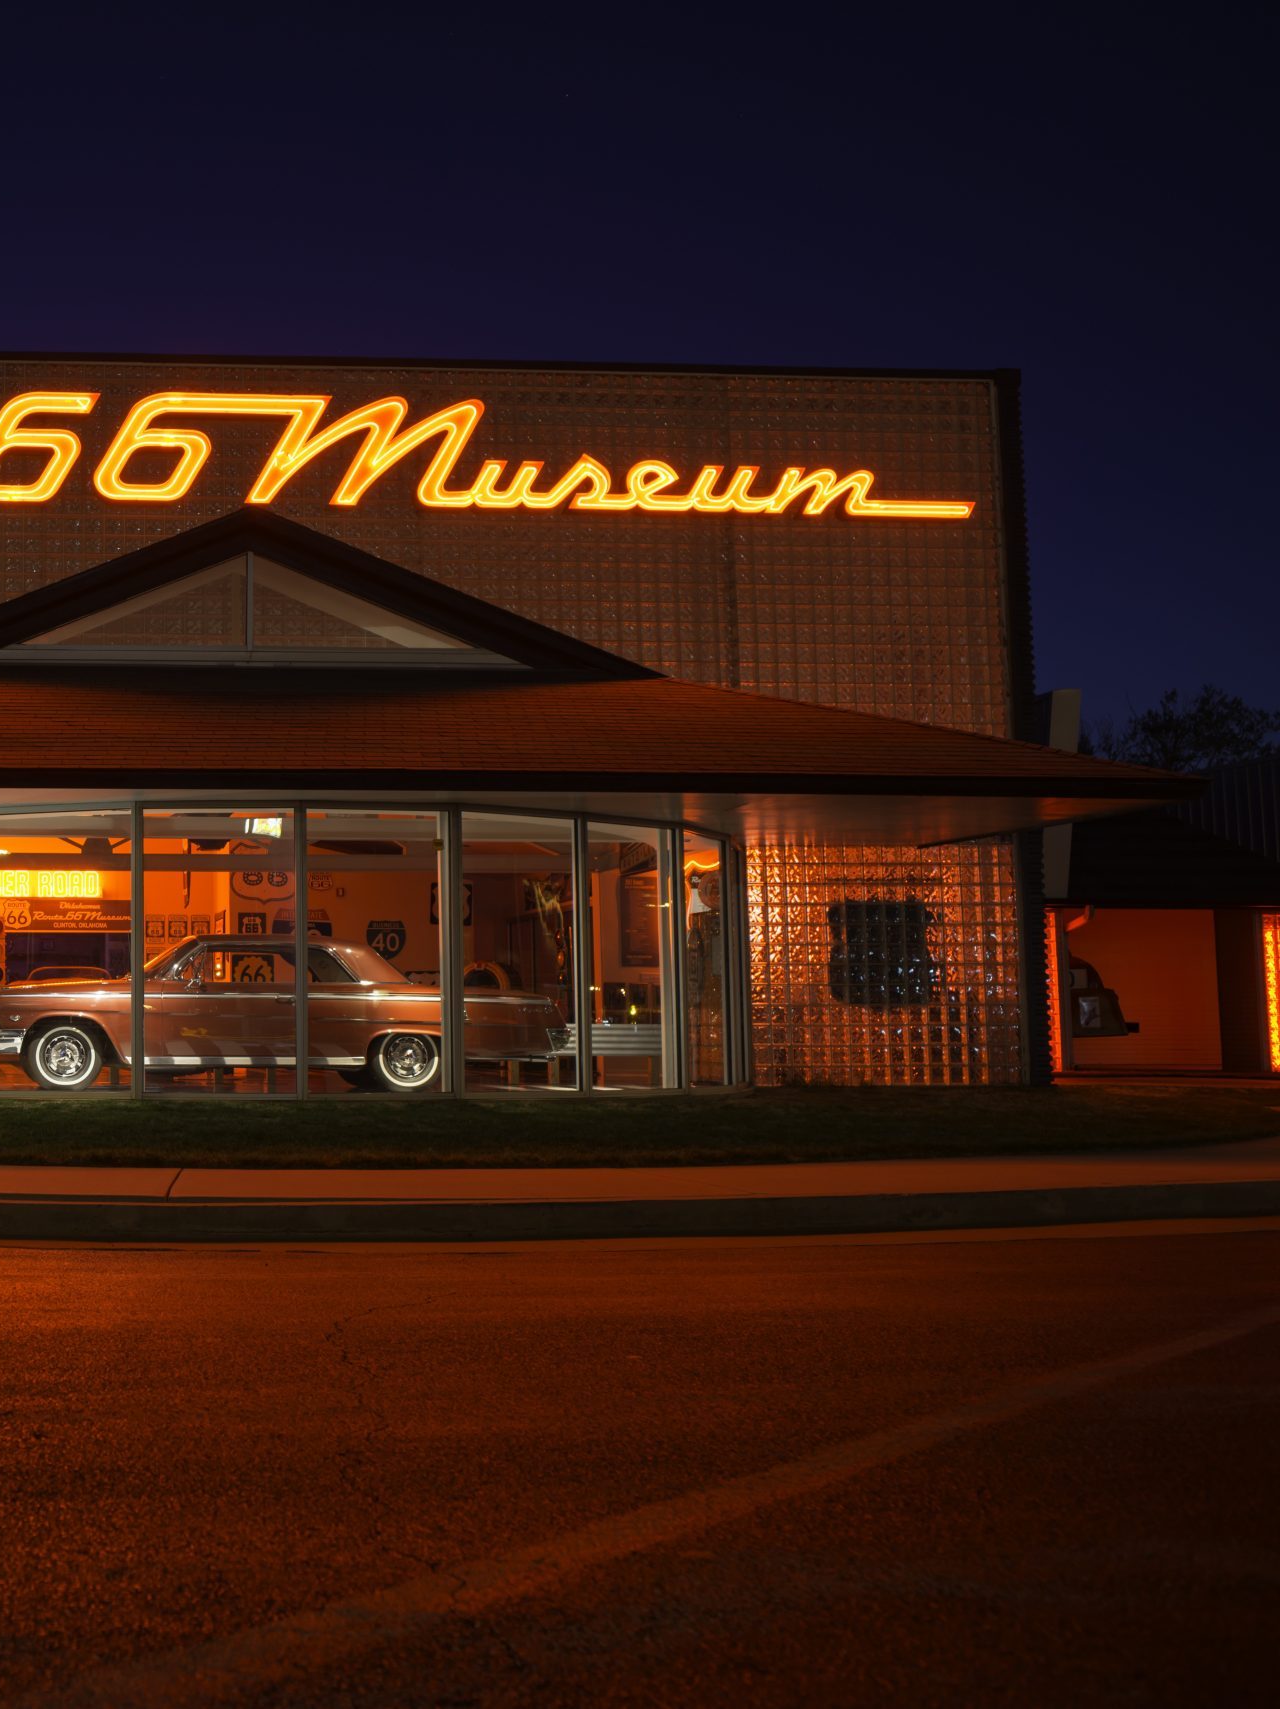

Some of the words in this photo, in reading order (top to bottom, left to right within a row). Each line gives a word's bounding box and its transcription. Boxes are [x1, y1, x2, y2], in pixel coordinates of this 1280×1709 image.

[244, 395, 976, 518] Museum
[37, 870, 100, 898] ROAD
[6, 910, 28, 925] 66
[32, 911, 66, 921] Route
[371, 931, 400, 952] 40
